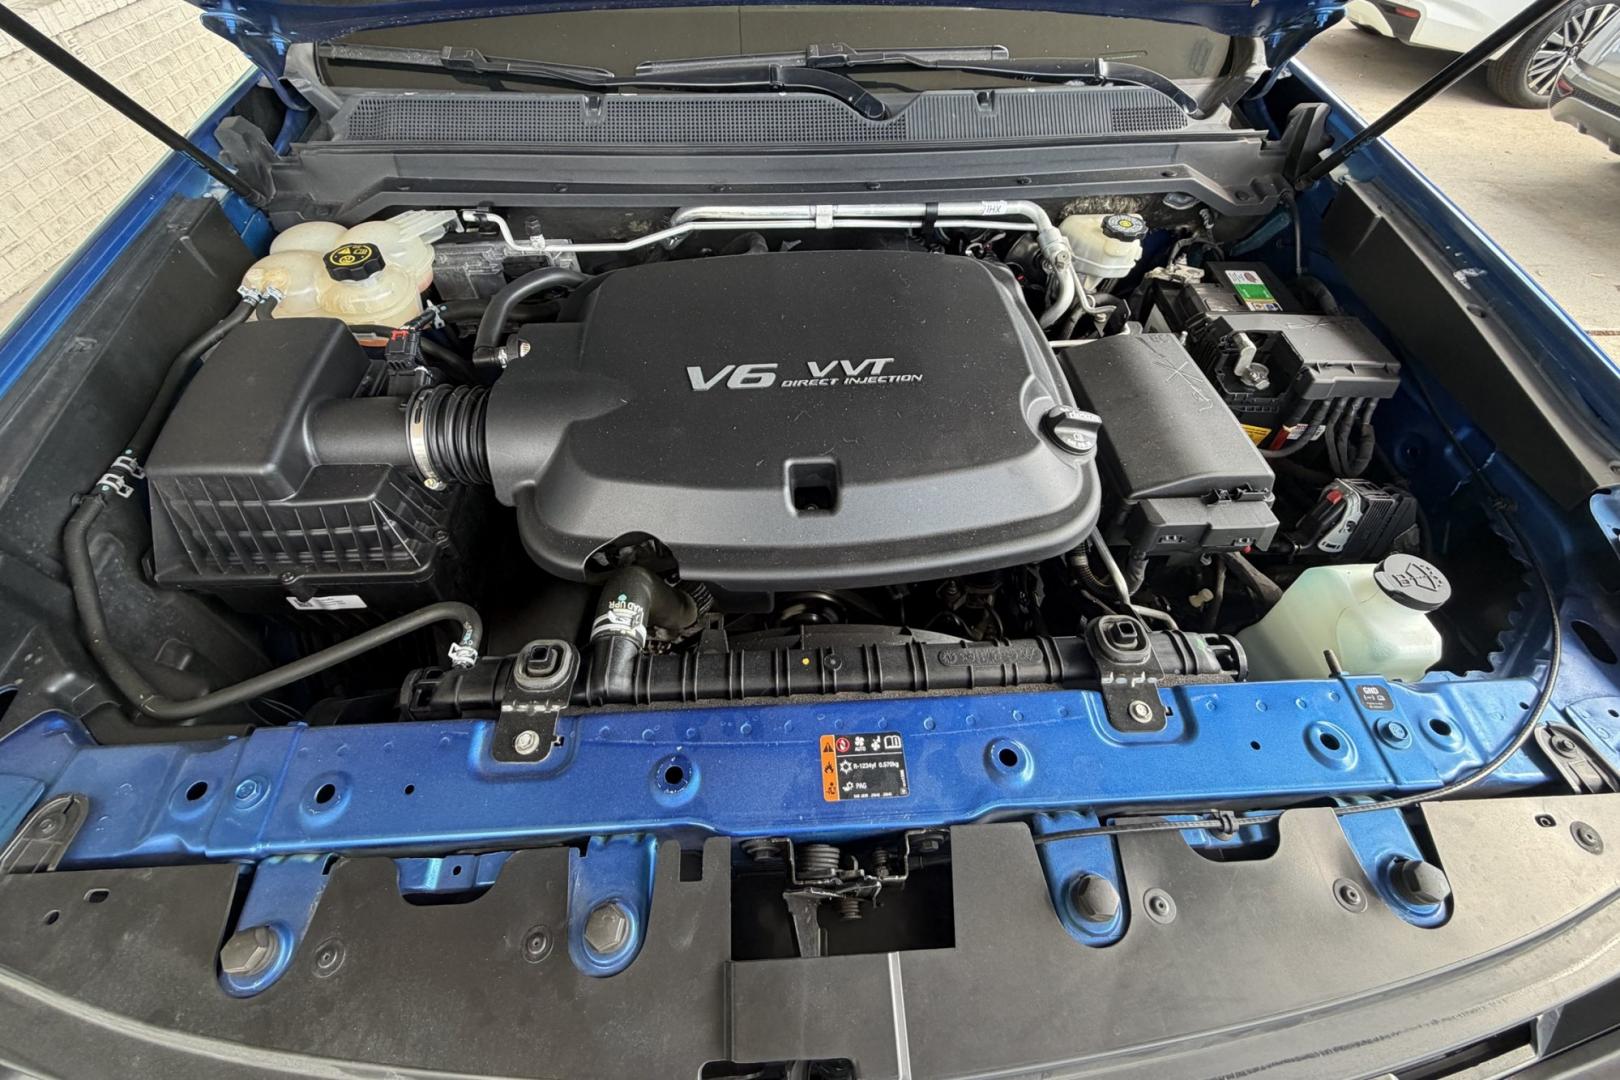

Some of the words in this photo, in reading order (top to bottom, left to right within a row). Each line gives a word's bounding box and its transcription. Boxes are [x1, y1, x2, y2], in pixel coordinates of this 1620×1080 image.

[686, 363, 778, 391] V6
[807, 357, 895, 377] VVT
[781, 378, 840, 388] DIRECT
[843, 373, 923, 385] INJECTION
